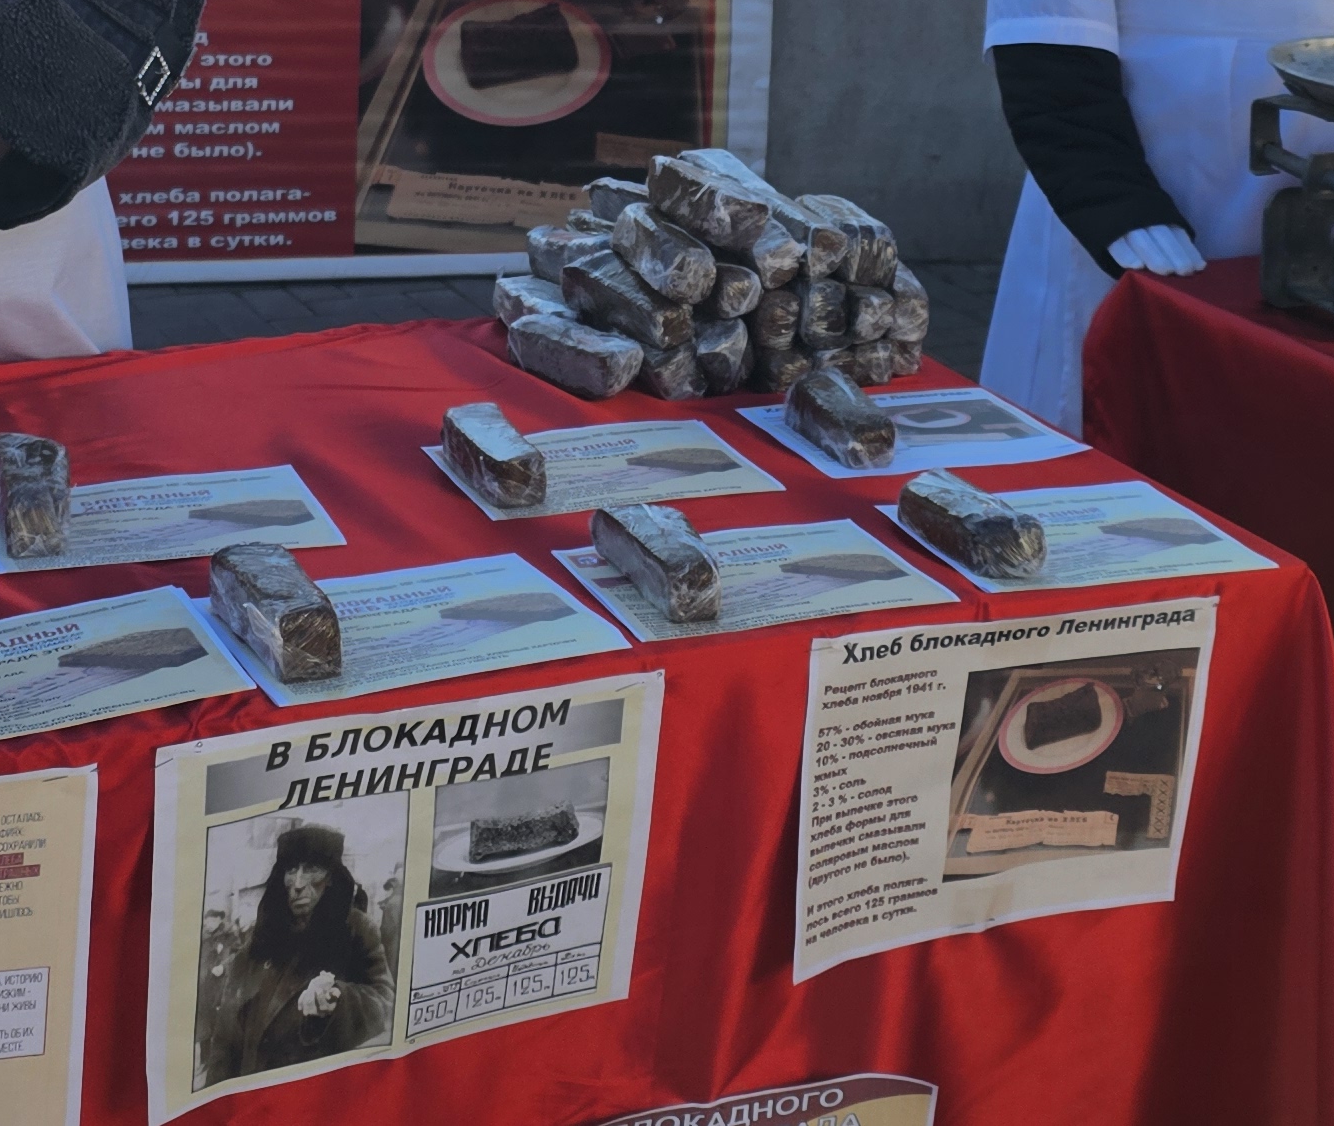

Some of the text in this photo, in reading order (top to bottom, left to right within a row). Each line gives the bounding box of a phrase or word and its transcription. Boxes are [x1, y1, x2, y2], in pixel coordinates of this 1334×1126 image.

[201, 55, 272, 66] этого
[210, 78, 257, 91] для
[155, 97, 293, 112] мазывали
[175, 122, 279, 134] маслом
[132, 142, 261, 159] не было).
[119, 188, 200, 204] хлеба
[168, 210, 336, 227] 125 граммов
[188, 234, 291, 250] в сутки.
[842, 608, 1197, 665] Хлеб блокадного Ленинграда
[824, 669, 938, 696] Рецепт блокадного
[822, 697, 858, 710] хлеба
[861, 688, 902, 703] ноября
[906, 682, 933, 694] 1941
[266, 698, 572, 770] В БЛОКАДНОМ
[278, 742, 554, 810] ЛЕНИНГРАДЕ
[424, 873, 602, 938] НОРМА ВЫДАЧИ
[449, 916, 562, 963] ХЛЕБА
